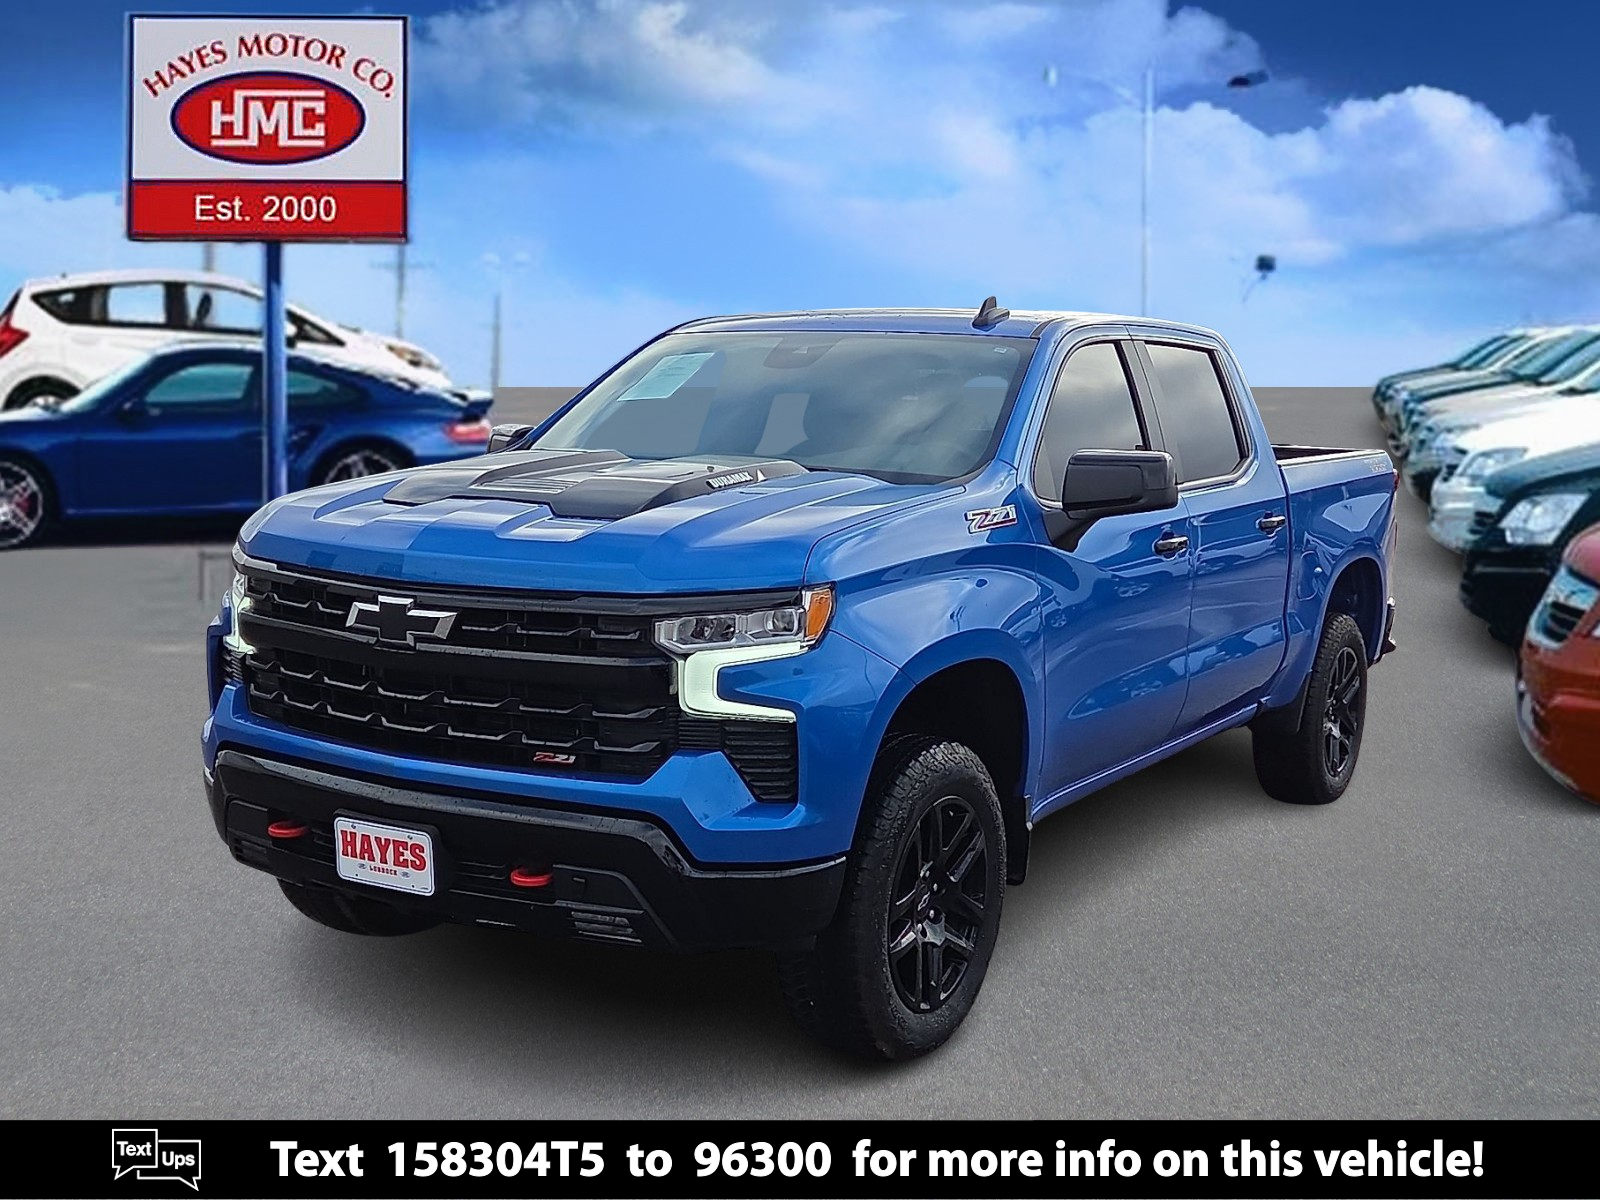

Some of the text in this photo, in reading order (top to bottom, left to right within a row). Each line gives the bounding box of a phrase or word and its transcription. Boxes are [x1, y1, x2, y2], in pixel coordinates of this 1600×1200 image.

[143, 33, 394, 98] HAYES MOTOR CO.
[211, 89, 325, 147] HMC
[195, 195, 337, 222] Est. 2000
[709, 471, 753, 489] DURAMAX
[964, 504, 1018, 534] Z71
[340, 829, 427, 871] HAYES
